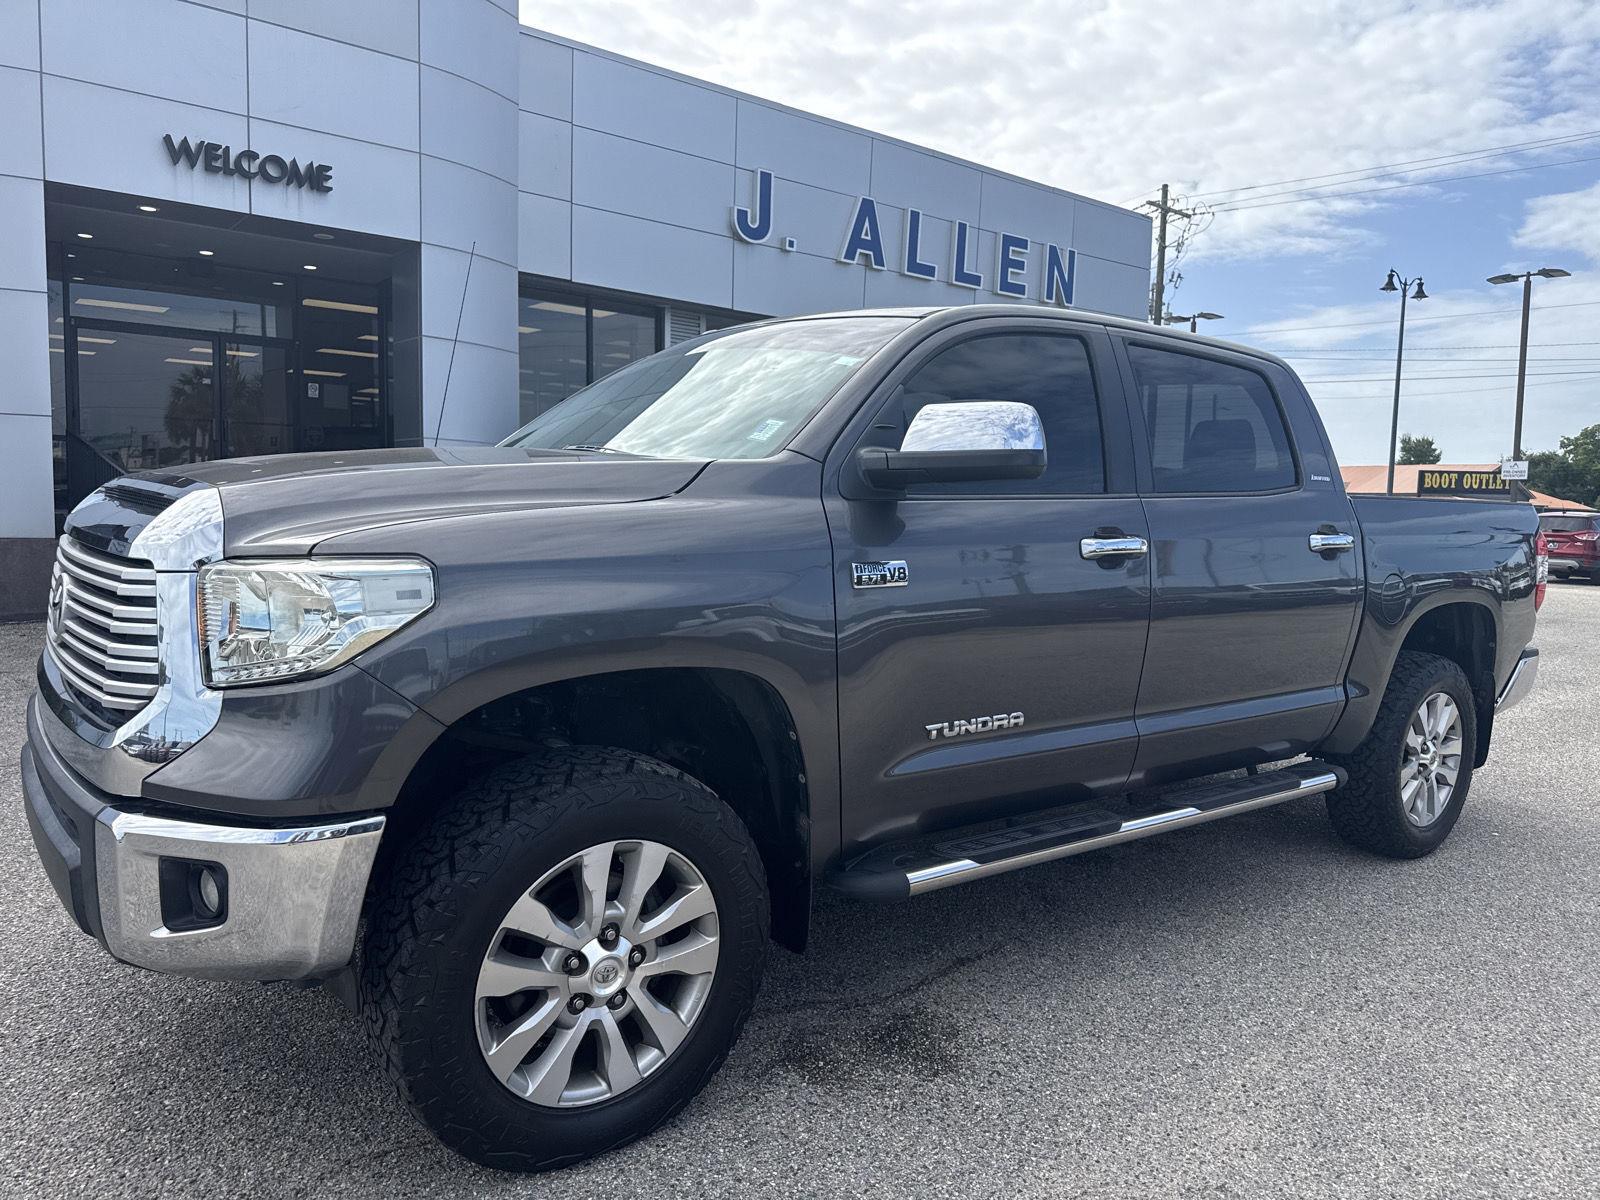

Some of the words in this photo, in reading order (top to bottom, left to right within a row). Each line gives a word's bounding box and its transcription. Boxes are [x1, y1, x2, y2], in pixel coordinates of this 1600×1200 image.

[163, 134, 333, 193] WELCOME
[732, 168, 797, 252] J.
[838, 195, 1078, 307] ALLEN
[1424, 472, 1458, 488] BOOT
[887, 566, 907, 582] V8
[925, 711, 1025, 740] TUNDRA
